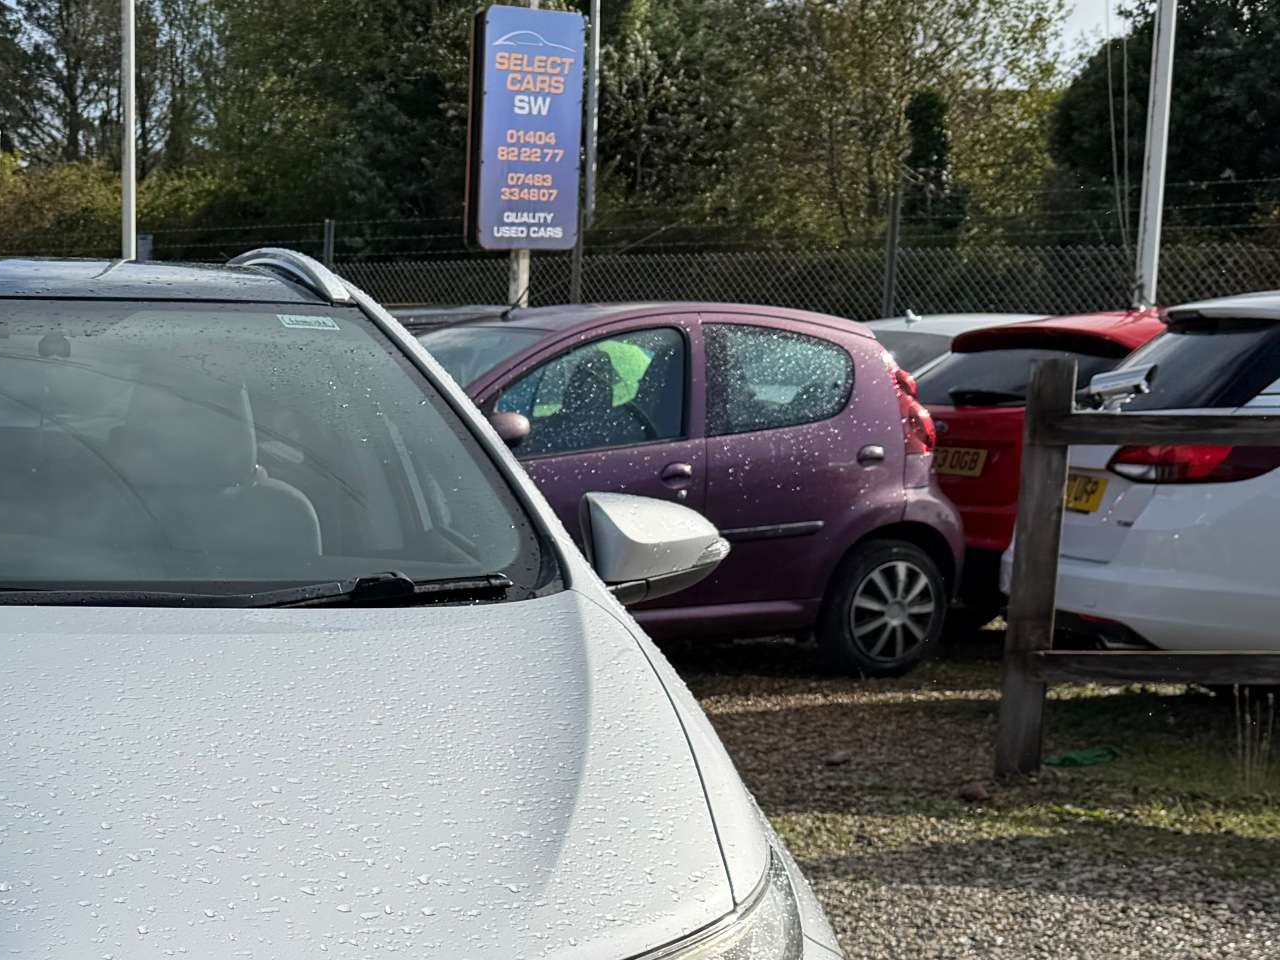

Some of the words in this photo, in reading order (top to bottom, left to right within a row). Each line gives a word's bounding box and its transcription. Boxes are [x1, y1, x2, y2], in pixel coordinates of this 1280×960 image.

[495, 52, 575, 75] SELECT
[506, 73, 565, 95] CARS
[513, 94, 551, 116] SW
[506, 129, 556, 145] 01404
[507, 172, 552, 187] 07483
[500, 187, 559, 202] 334807
[503, 211, 554, 225] QUALITY
[493, 225, 528, 238] USED
[529, 226, 564, 239] CARS
